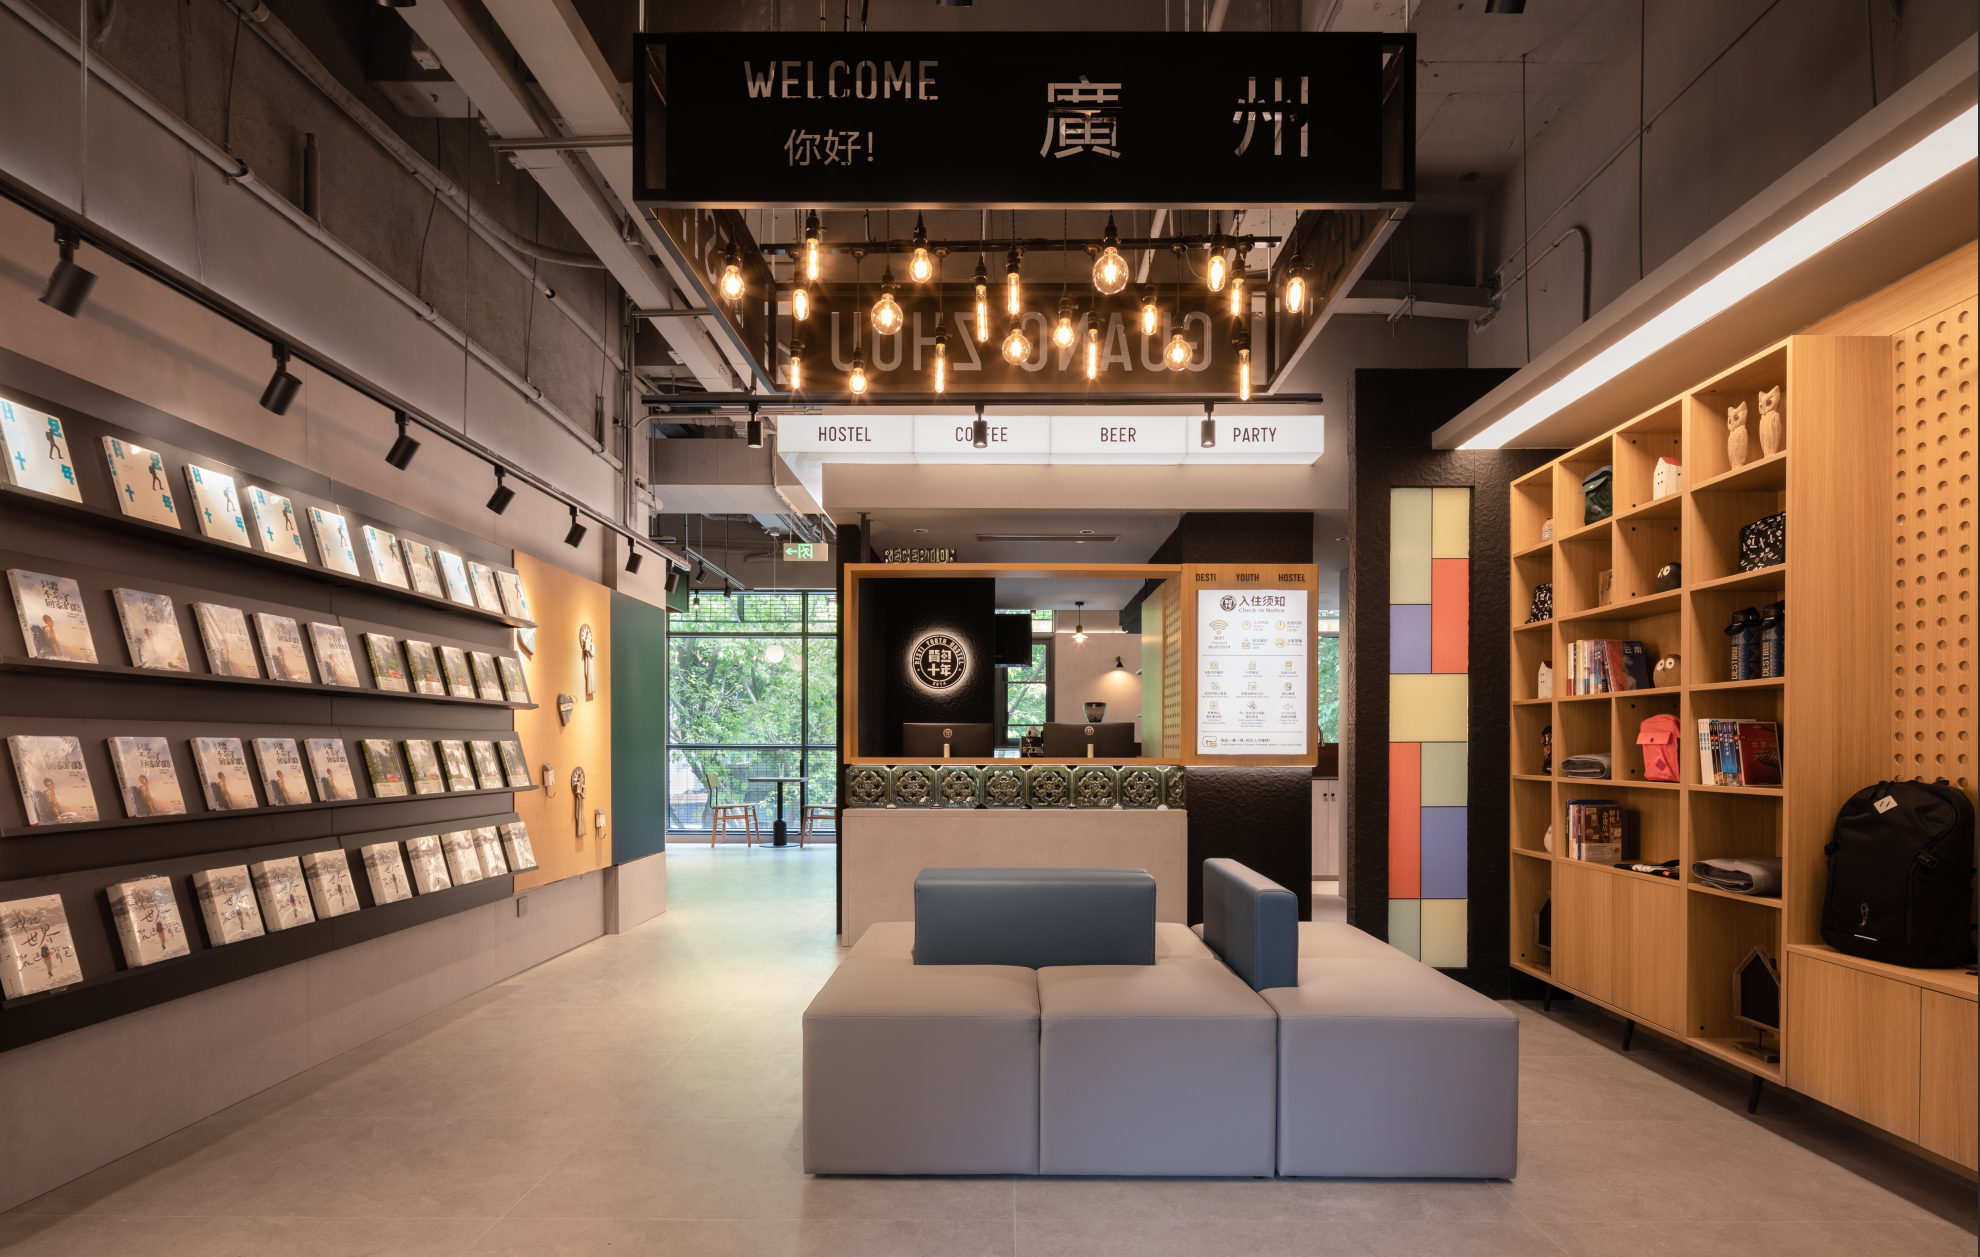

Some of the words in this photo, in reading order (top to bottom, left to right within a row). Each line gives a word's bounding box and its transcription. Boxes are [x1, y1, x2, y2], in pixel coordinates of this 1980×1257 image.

[744, 60, 939, 101] WELCOME
[818, 426, 872, 442] HOSTEL
[955, 426, 1008, 442] COEE
[1100, 427, 1137, 443] BEER
[1233, 427, 1277, 443] PARTY
[14, 451, 27, 471] 十
[125, 484, 135, 503] 十
[204, 507, 213, 524] 十
[267, 526, 274, 542] 十
[883, 548, 957, 563] RECEPTION
[1195, 573, 1216, 582] DESTI
[1235, 573, 1260, 582] YOUTH
[1278, 573, 1306, 582] HOSTEL
[1238, 595, 1286, 607] 入住须知
[928, 648, 952, 663] 背包
[1624, 645, 1643, 655] 云南
[927, 663, 952, 677] 十年
